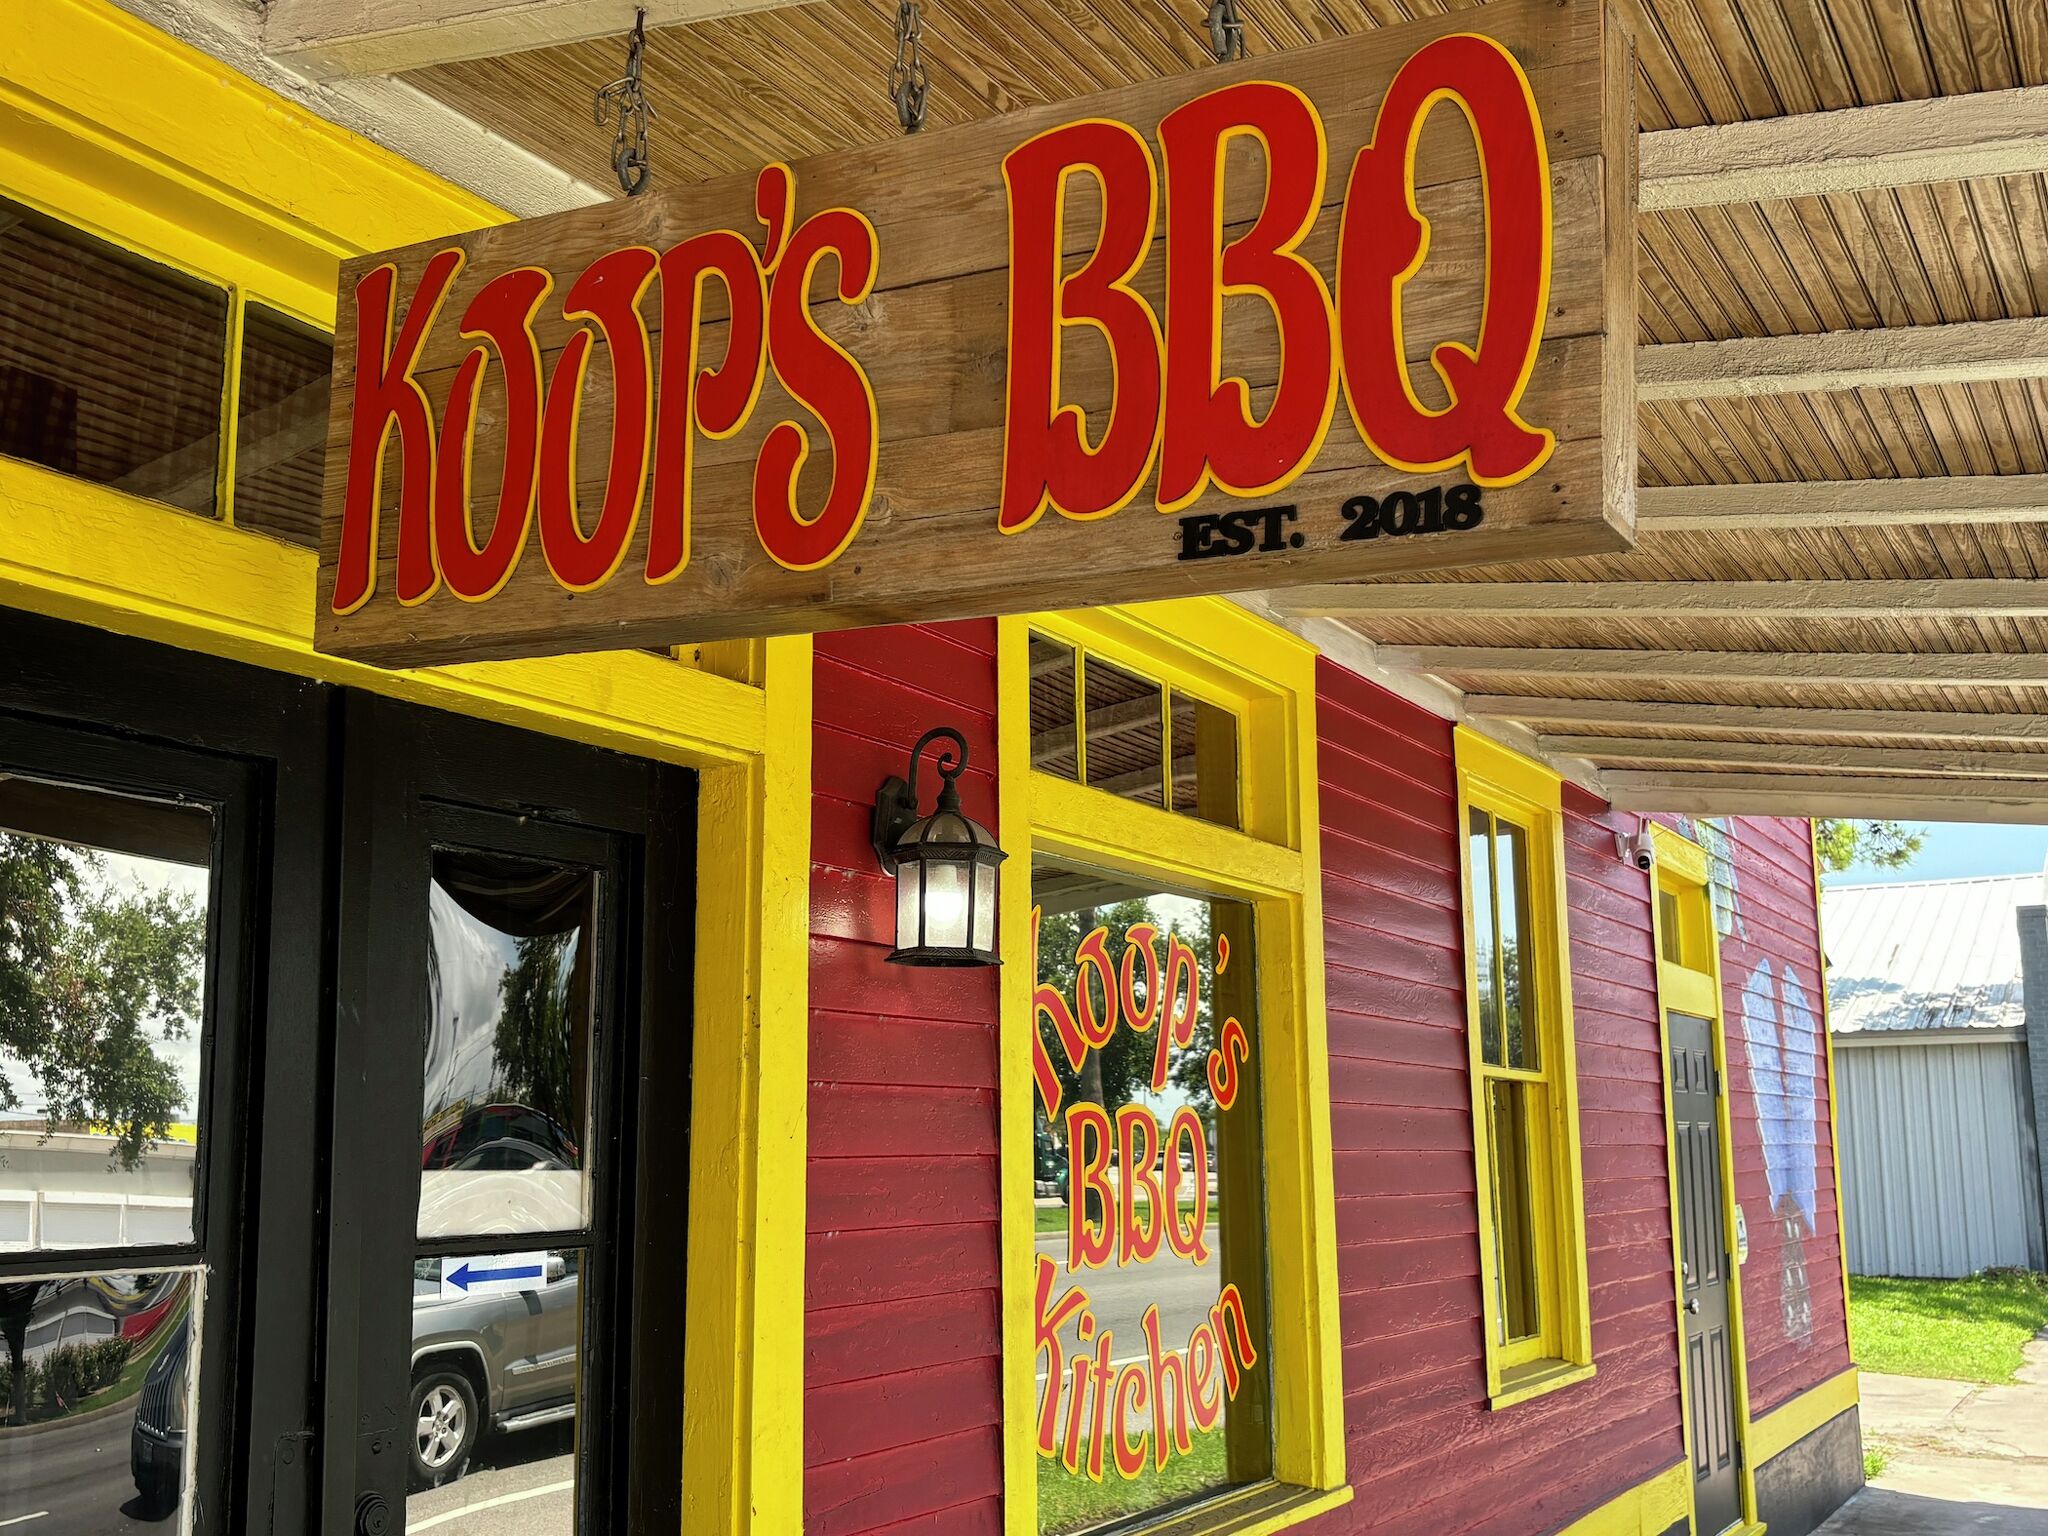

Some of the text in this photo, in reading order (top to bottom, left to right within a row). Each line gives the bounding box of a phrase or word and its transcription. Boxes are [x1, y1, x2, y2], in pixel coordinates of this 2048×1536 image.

[332, 32, 1556, 614] KOOP'S BBQ
[1178, 484, 1484, 561] EST. 2018
[1066, 1102, 1213, 1273] BBQ
[1035, 1253, 1257, 1483] Kitchen
